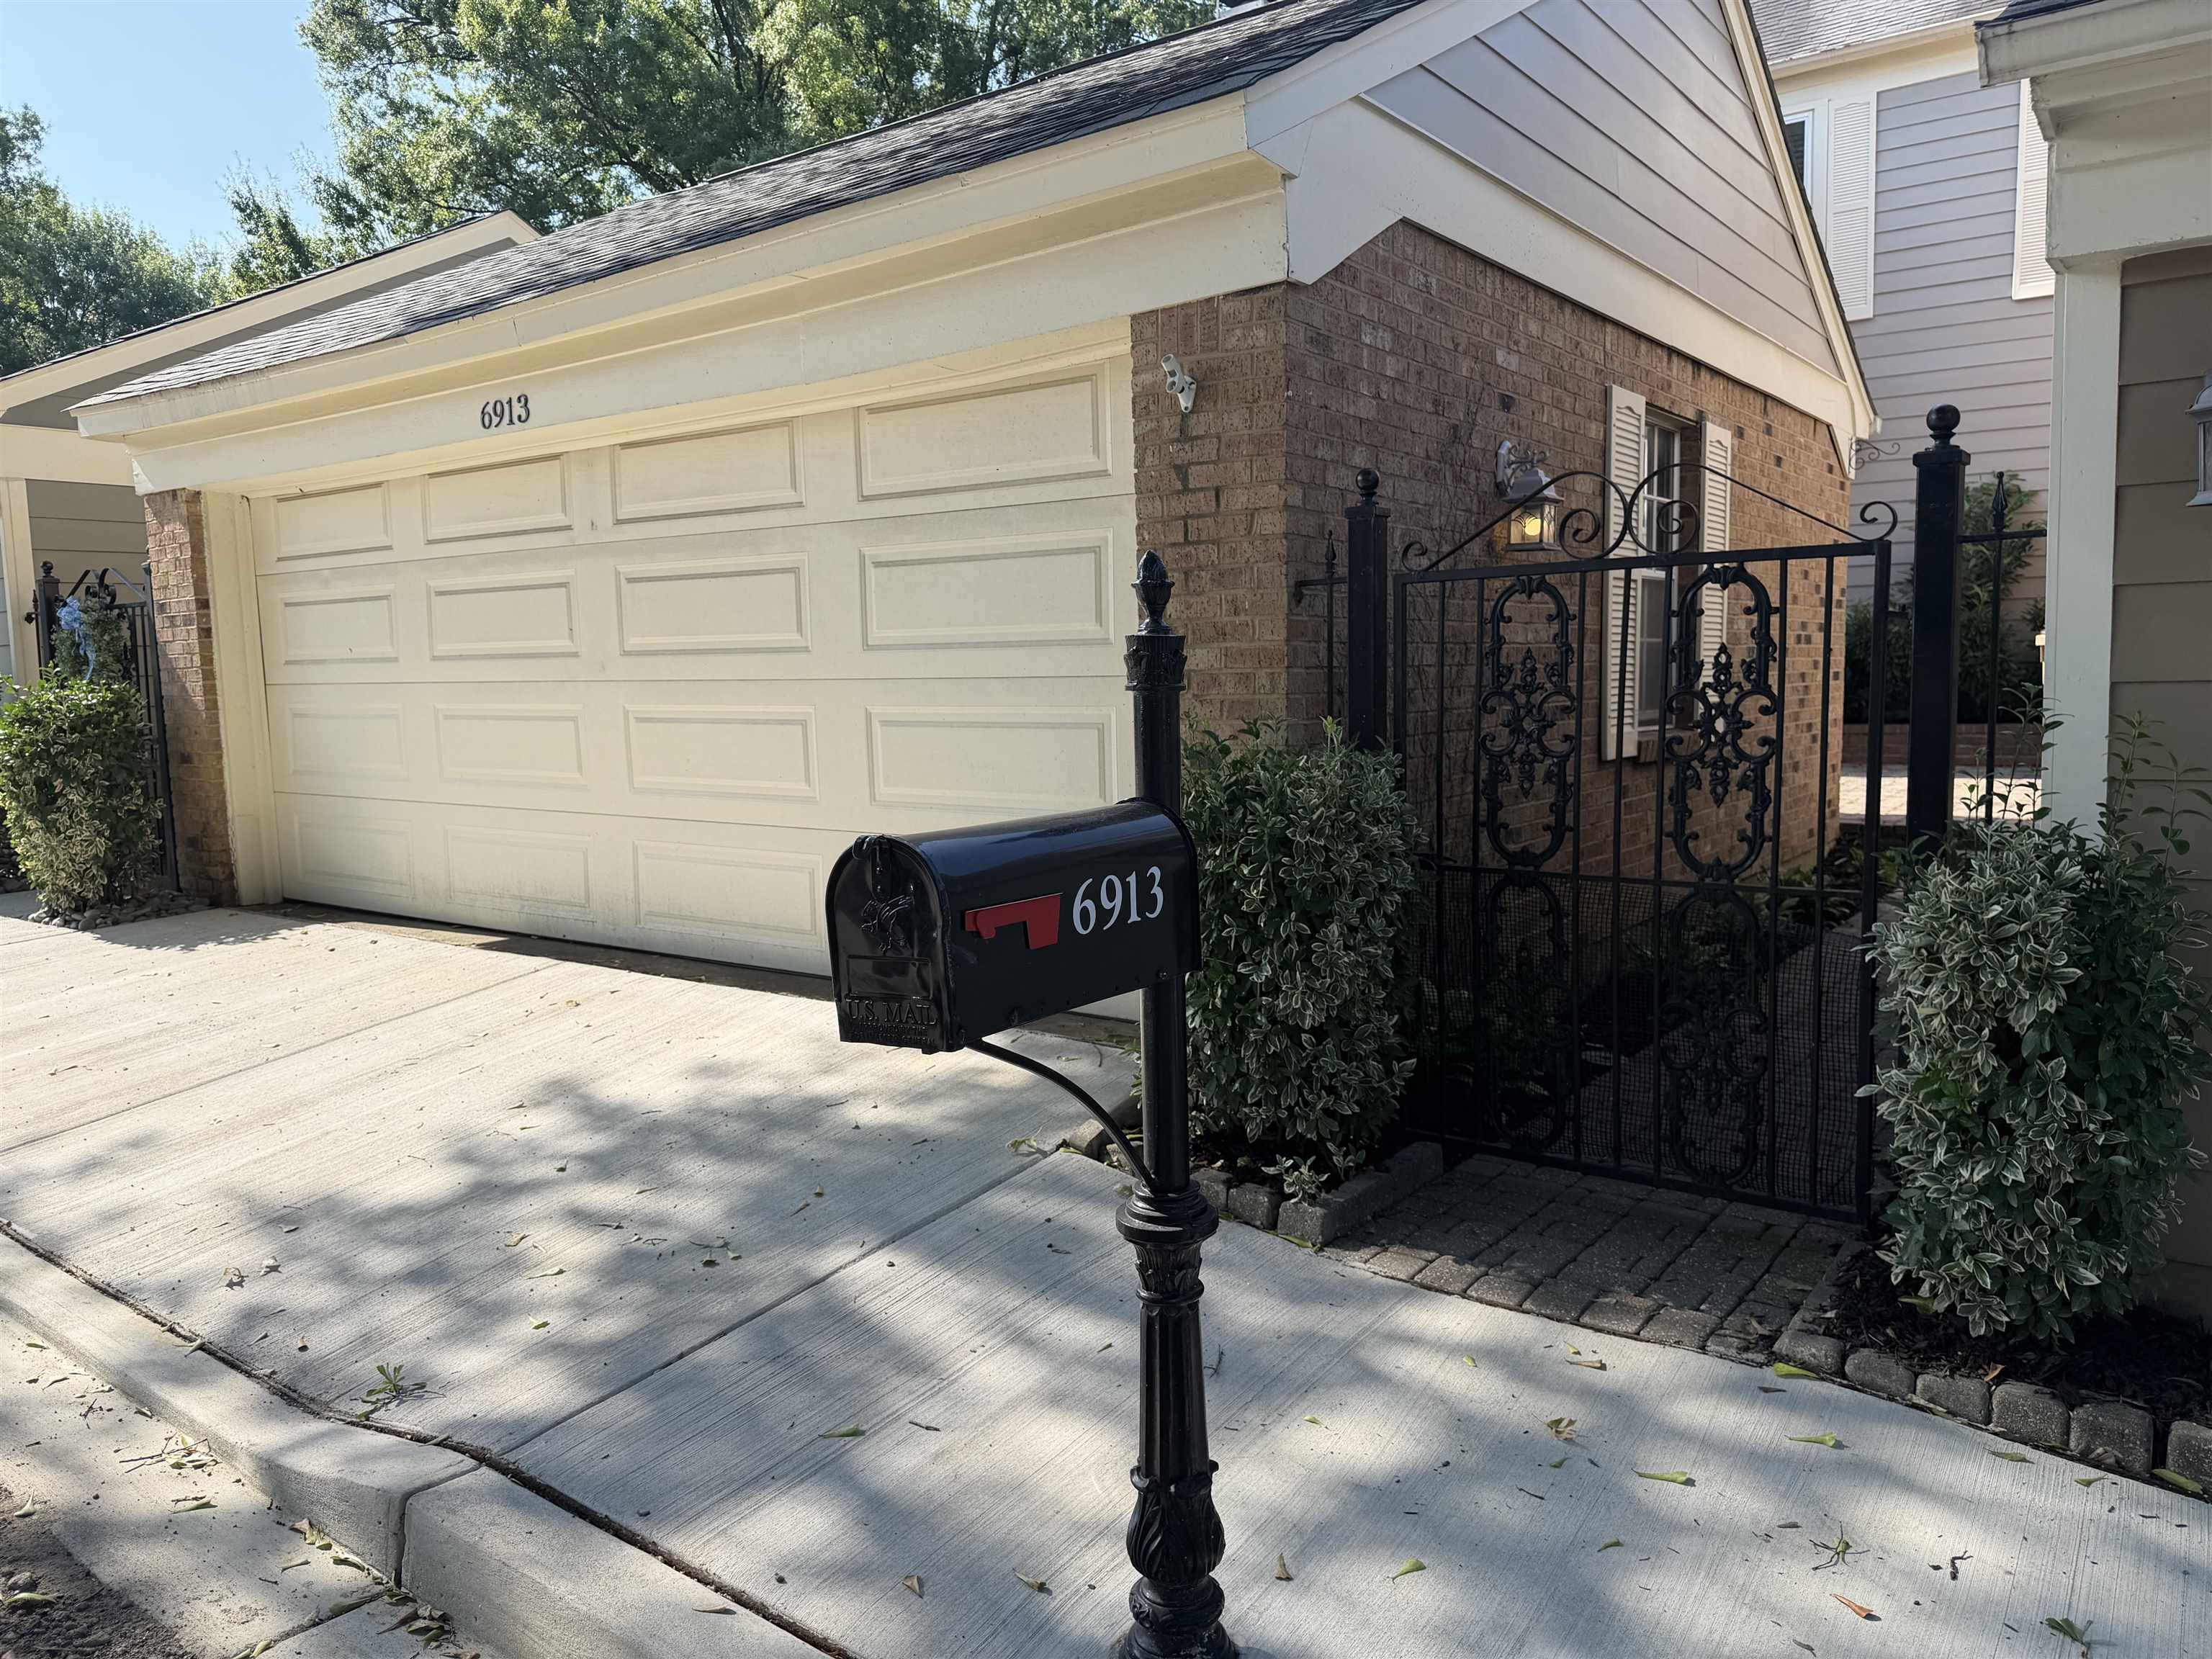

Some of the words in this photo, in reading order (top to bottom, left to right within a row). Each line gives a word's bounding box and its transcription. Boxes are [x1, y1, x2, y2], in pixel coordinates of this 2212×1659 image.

[480, 394, 530, 429] 6913
[1072, 866, 1164, 935] 6913
[845, 998, 878, 1020] U.S.
[882, 1002, 938, 1025] MAIL
